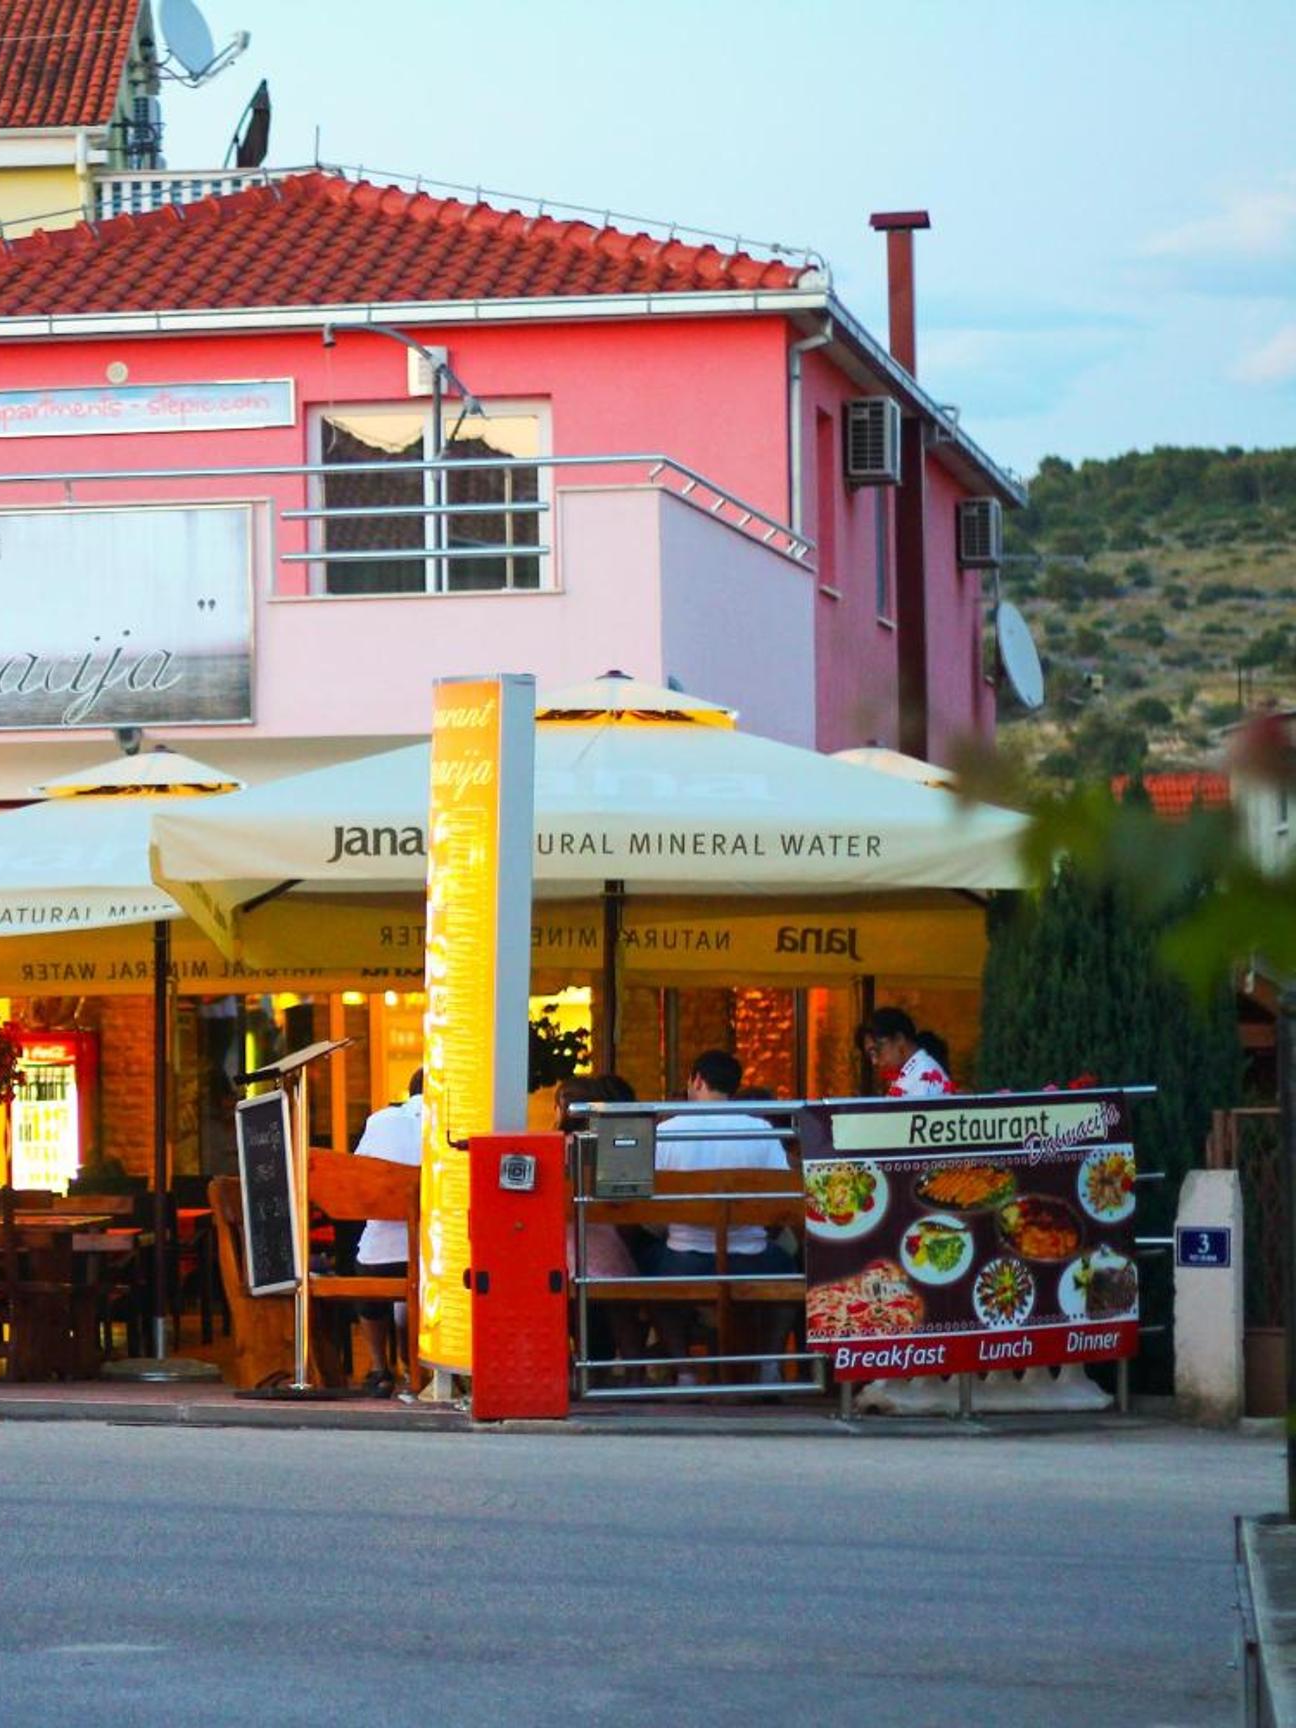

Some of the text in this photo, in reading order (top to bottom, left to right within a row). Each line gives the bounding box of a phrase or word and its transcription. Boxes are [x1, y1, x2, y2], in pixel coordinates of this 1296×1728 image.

[326, 826, 883, 863] jana URAL MINERAL WATER
[909, 1111, 1050, 1144] Restaurant
[1197, 1233, 1210, 1254] 3
[835, 1330, 1121, 1369] Breakfast Lunch Dinner
